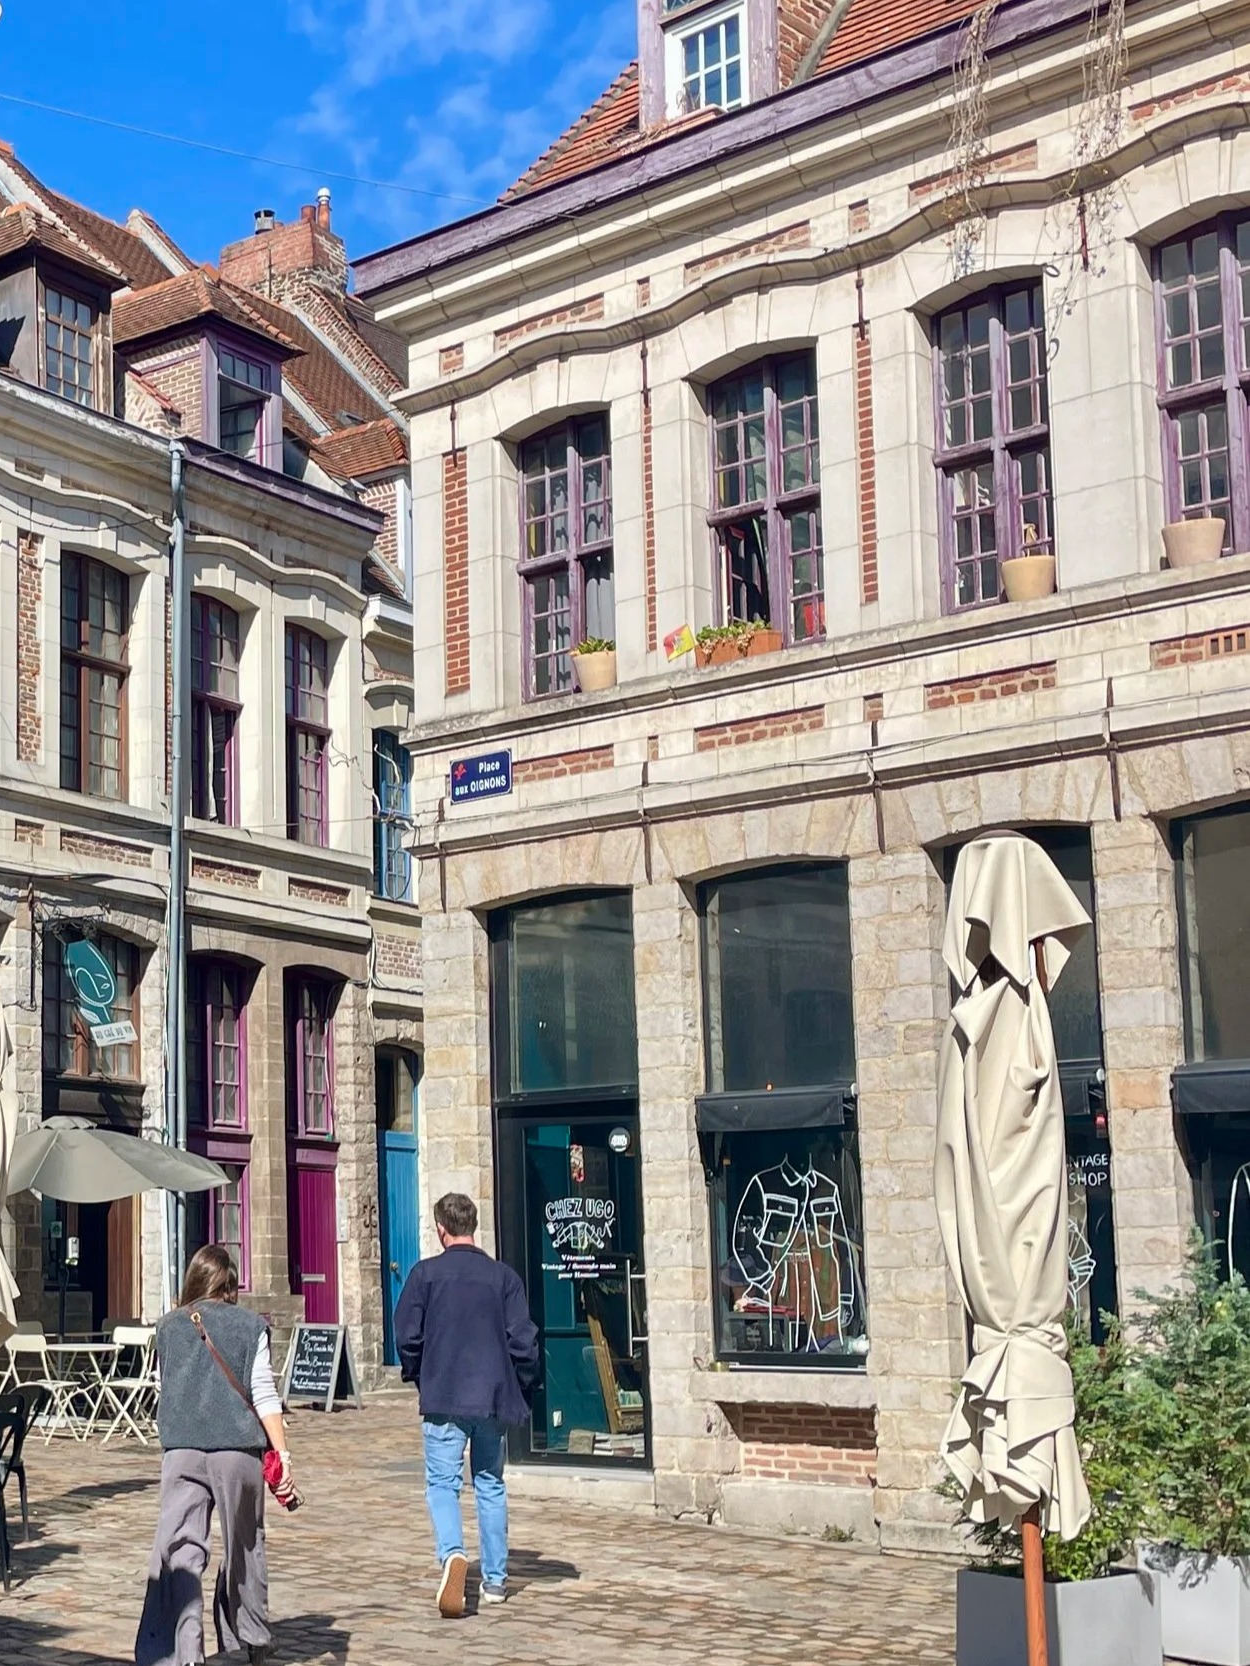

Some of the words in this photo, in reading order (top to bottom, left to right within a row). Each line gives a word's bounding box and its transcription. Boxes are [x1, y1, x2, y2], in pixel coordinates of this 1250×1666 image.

[479, 761, 500, 773] Place
[455, 785, 468, 795] aux
[470, 775, 506, 792] OIGNONS
[1069, 1154, 1108, 1168] NTAGE
[1069, 1172, 1107, 1186] SHOP
[546, 1198, 582, 1220] CHEZ
[586, 1198, 614, 1219] UGO
[599, 1262, 616, 1270] main
